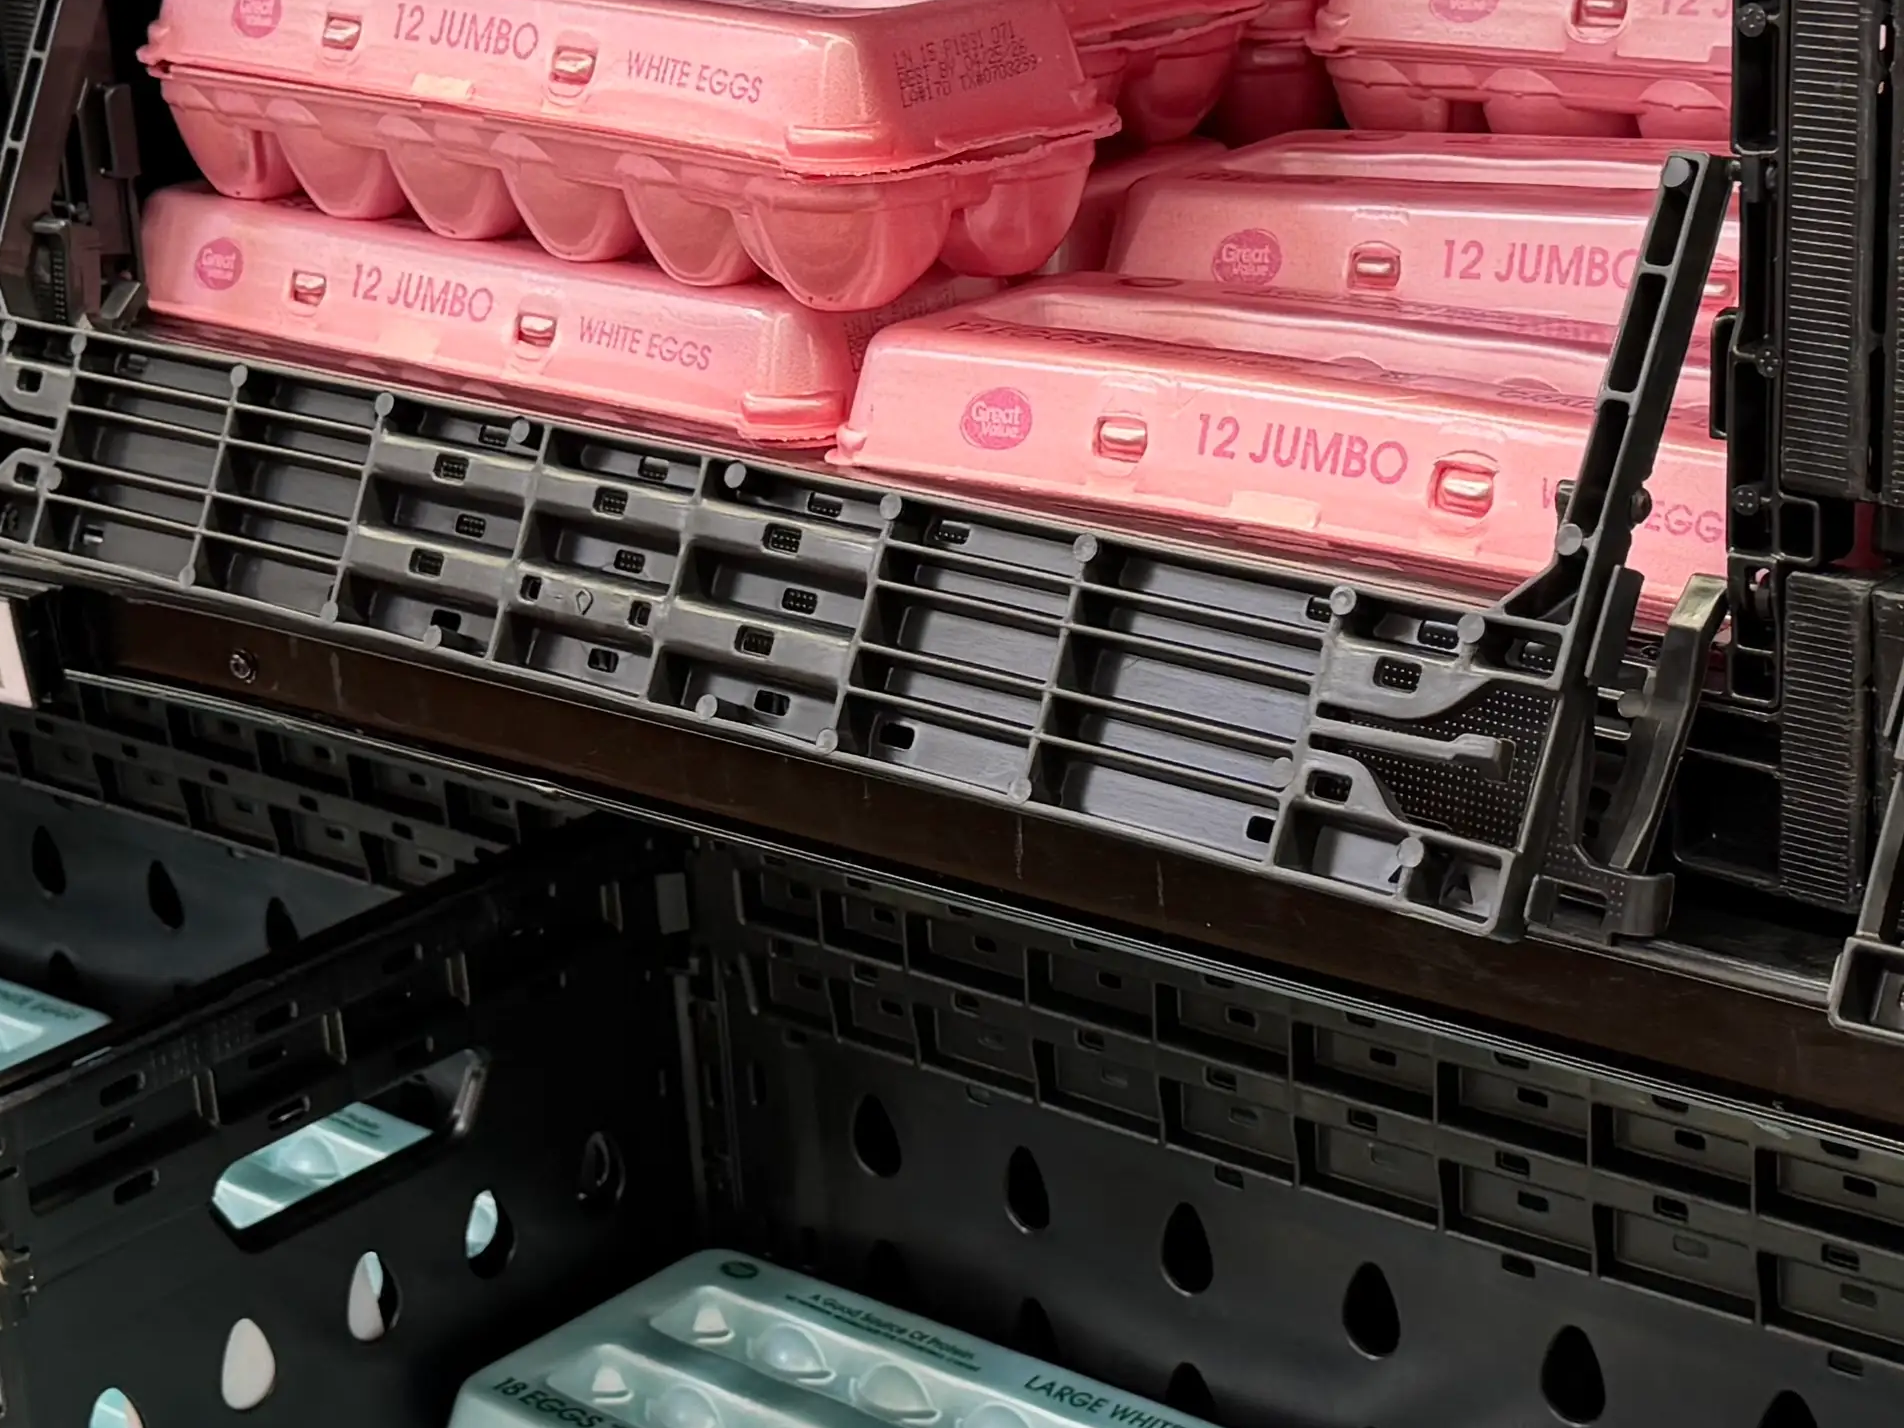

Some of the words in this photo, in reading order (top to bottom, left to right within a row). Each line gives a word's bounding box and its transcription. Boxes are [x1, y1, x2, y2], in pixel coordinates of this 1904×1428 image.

[393, 3, 424, 41] 12
[430, 10, 539, 60] JUMBO
[627, 50, 694, 88] WHITE
[697, 64, 762, 104] EGGS
[1443, 240, 1483, 280] 12
[970, 404, 1023, 430] Great
[1196, 413, 1238, 461] 12
[1249, 424, 1409, 486] JUMBO
